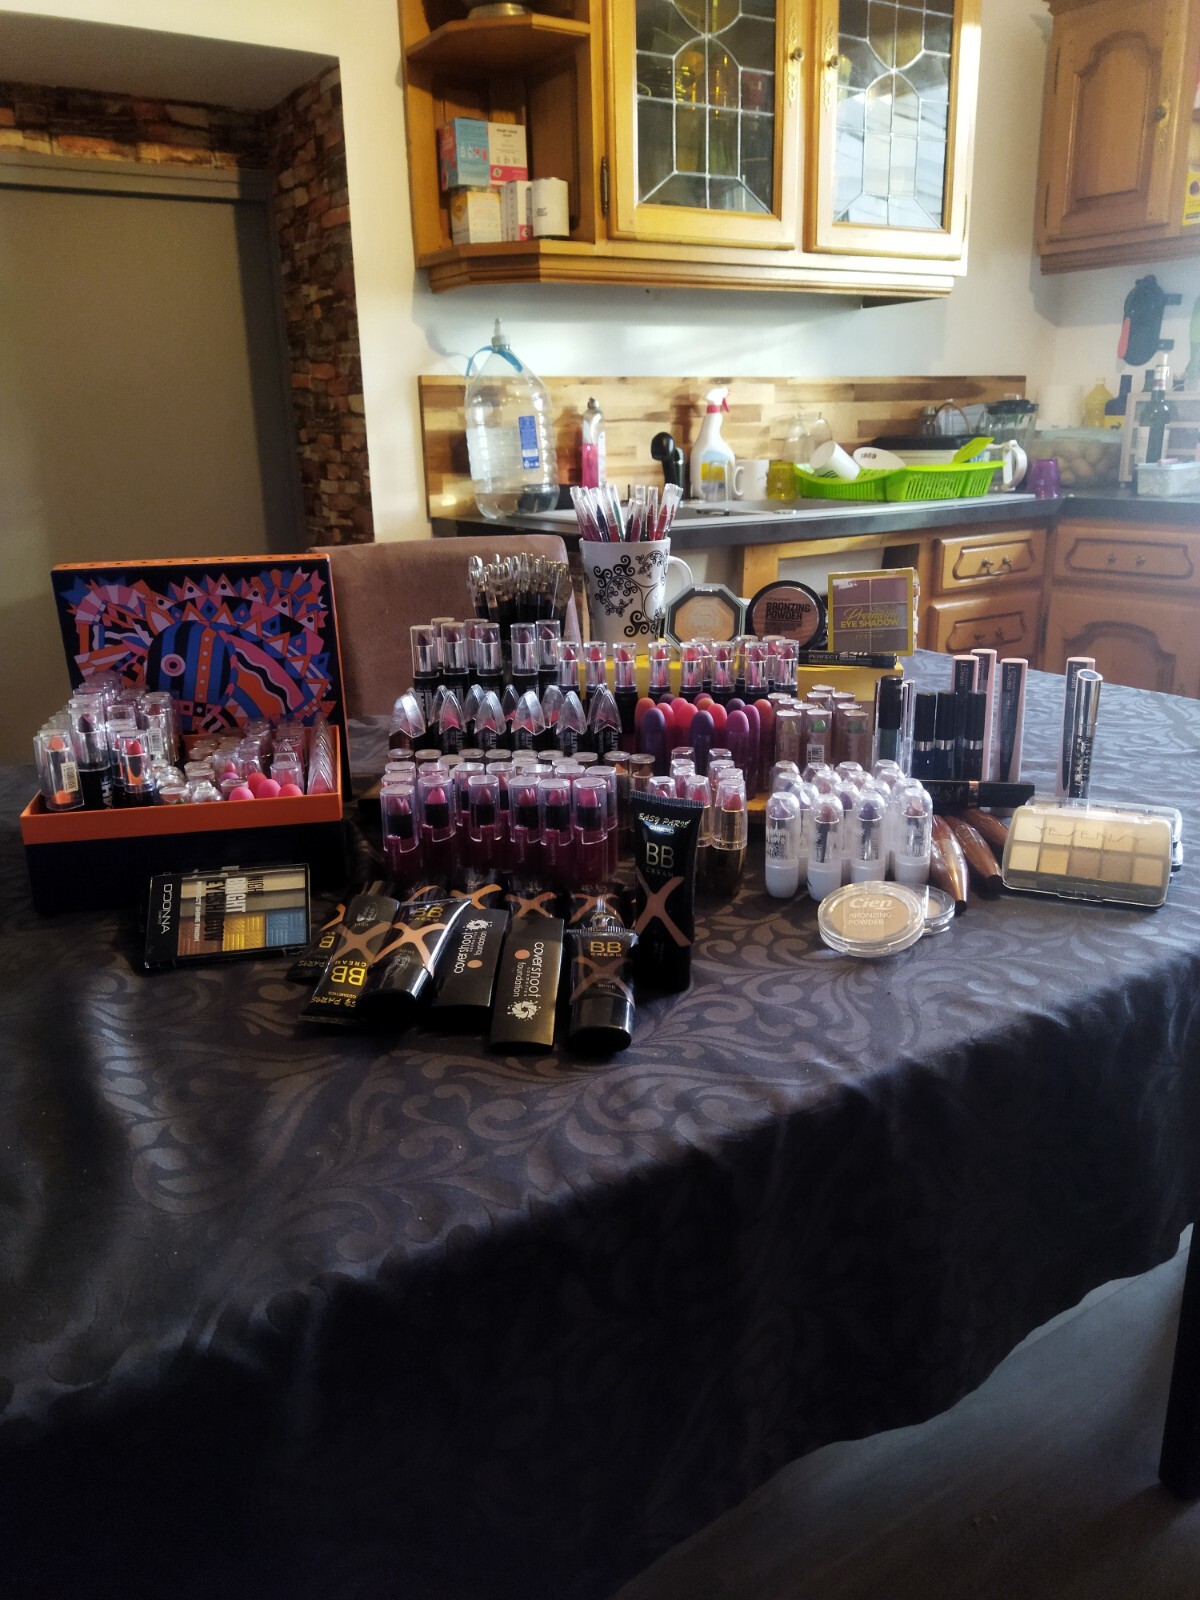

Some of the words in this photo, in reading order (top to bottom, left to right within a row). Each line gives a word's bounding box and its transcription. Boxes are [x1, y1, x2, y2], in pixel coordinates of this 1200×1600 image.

[765, 611, 803, 620] POWDER
[766, 602, 811, 612] BRONZING
[840, 620, 858, 628] EYE
[858, 618, 899, 628] SHADOW
[1006, 664, 1016, 690] IMPACT
[1071, 663, 1081, 689] IMPACT
[646, 842, 675, 868] BB
[225, 878, 246, 912] BRIGHT
[849, 898, 894, 910] Cien
[413, 906, 443, 918] BB
[454, 929, 474, 974] covershoot
[474, 930, 488, 956] foundation
[591, 941, 622, 953] BB
[331, 965, 366, 986] BB
[335, 960, 367, 968] CREAM
[528, 942, 544, 998] covershoot
[513, 962, 526, 997] foundation
